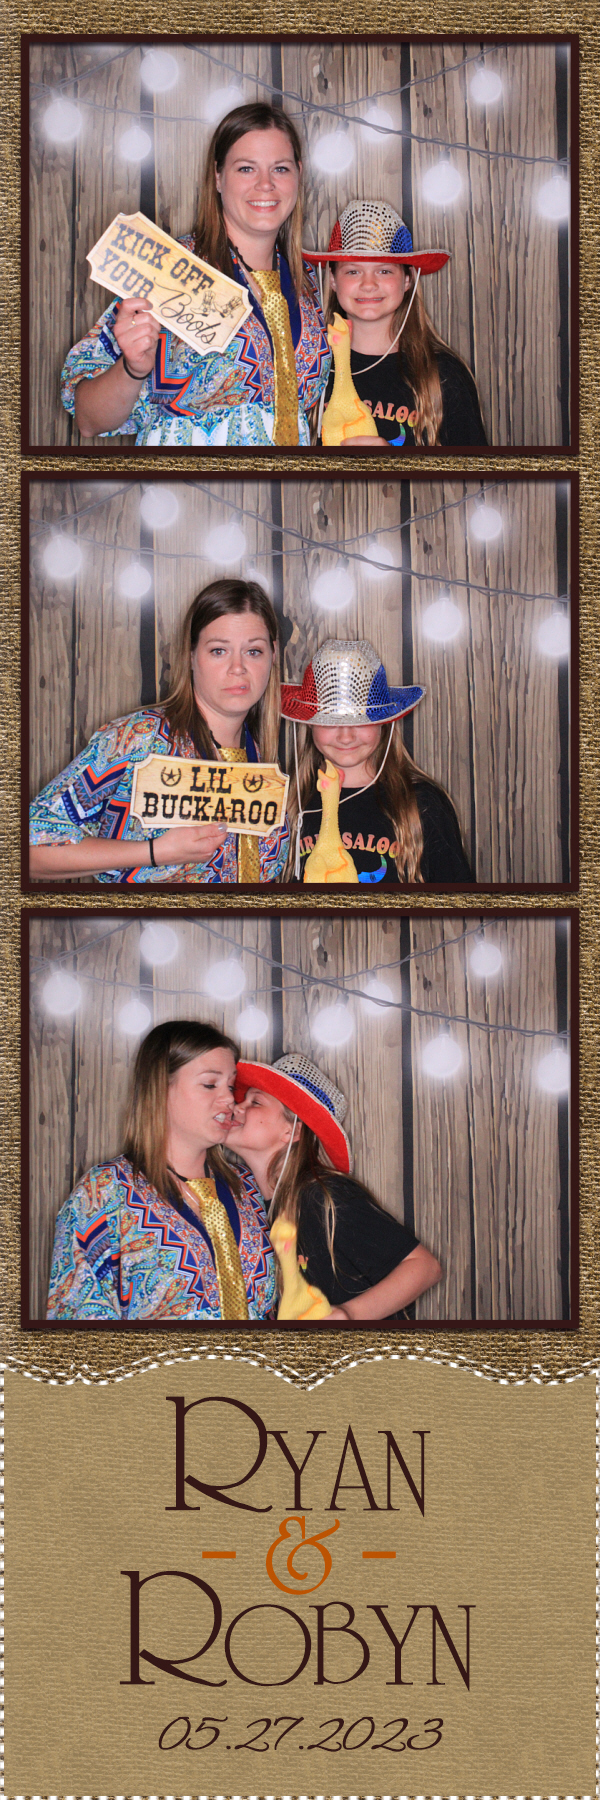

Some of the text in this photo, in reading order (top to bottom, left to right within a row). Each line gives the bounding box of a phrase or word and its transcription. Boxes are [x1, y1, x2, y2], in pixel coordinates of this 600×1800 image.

[97, 248, 154, 299] YOUR
[110, 223, 215, 295] KICK OFF
[153, 277, 221, 345] Boots
[363, 399, 419, 428] SALOO
[190, 766, 234, 795] LIL'
[142, 792, 278, 826] BUCK-A-ROO
[342, 831, 400, 858] SALOO
